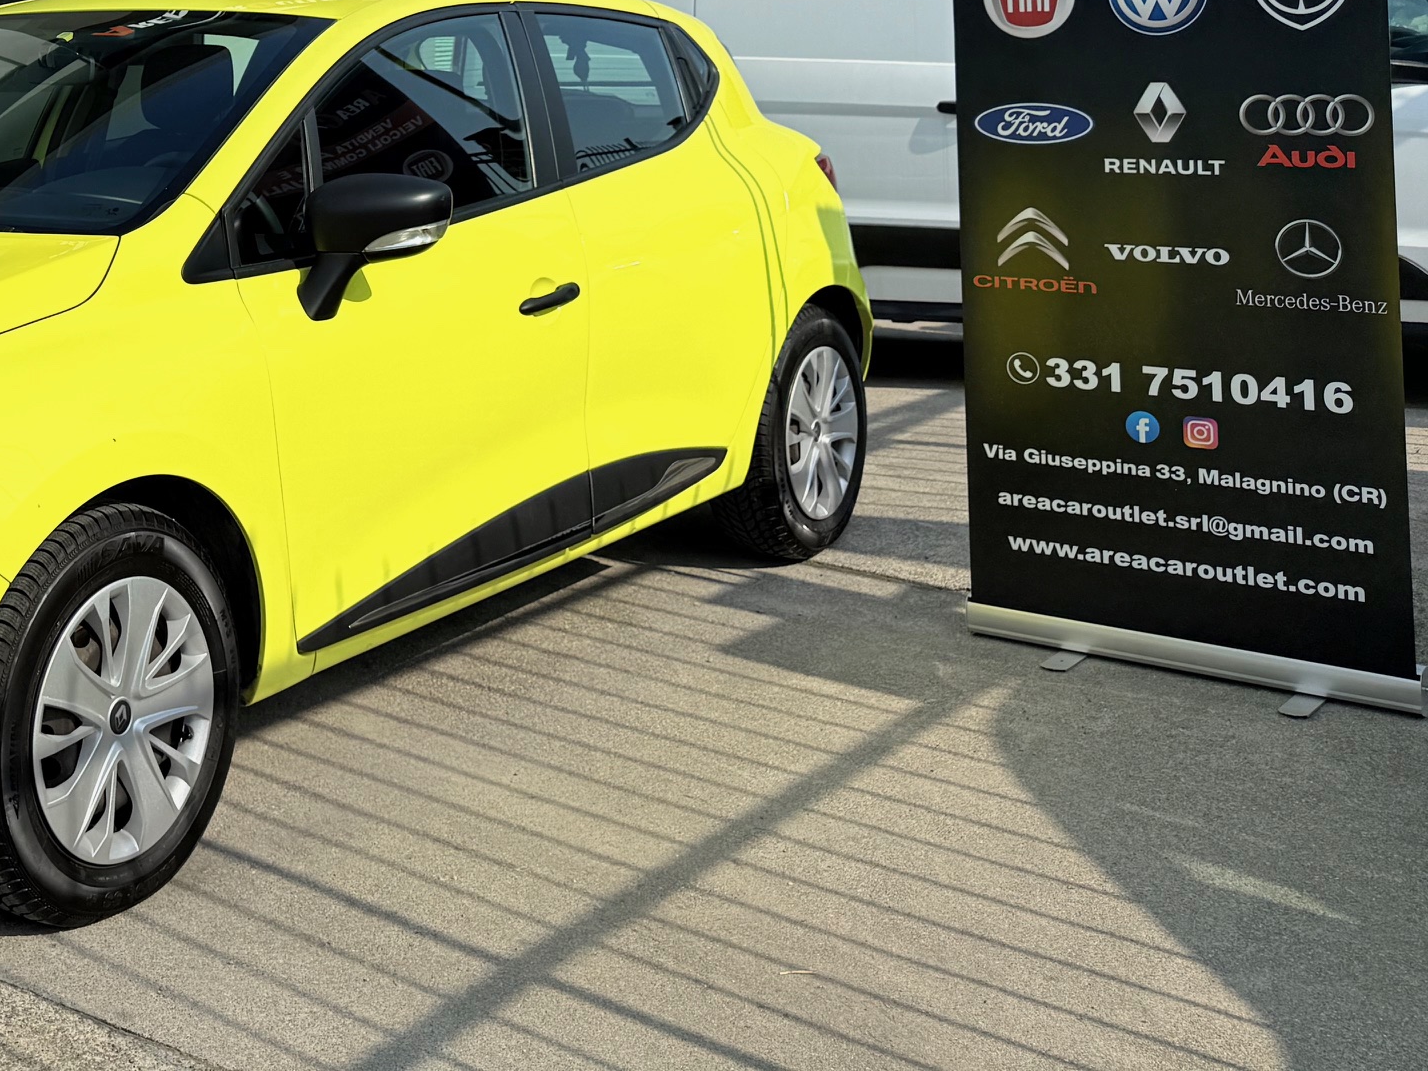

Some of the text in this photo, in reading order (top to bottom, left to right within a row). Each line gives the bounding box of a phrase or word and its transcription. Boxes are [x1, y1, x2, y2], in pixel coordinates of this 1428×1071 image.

[997, 107, 1071, 139] Ford
[1103, 157, 1226, 176] RENAULT
[1104, 242, 1231, 267] VOLVO
[1235, 288, 1388, 316] Mercedes-Benz
[1045, 357, 1355, 415] 331 7510416
[983, 442, 1388, 509] Via Giuseppina 33, Malagnino (CR)
[998, 490, 1375, 555] areacaroutlet.srl@gmail.com
[1008, 534, 1367, 603] www.areacaroutlet.com
